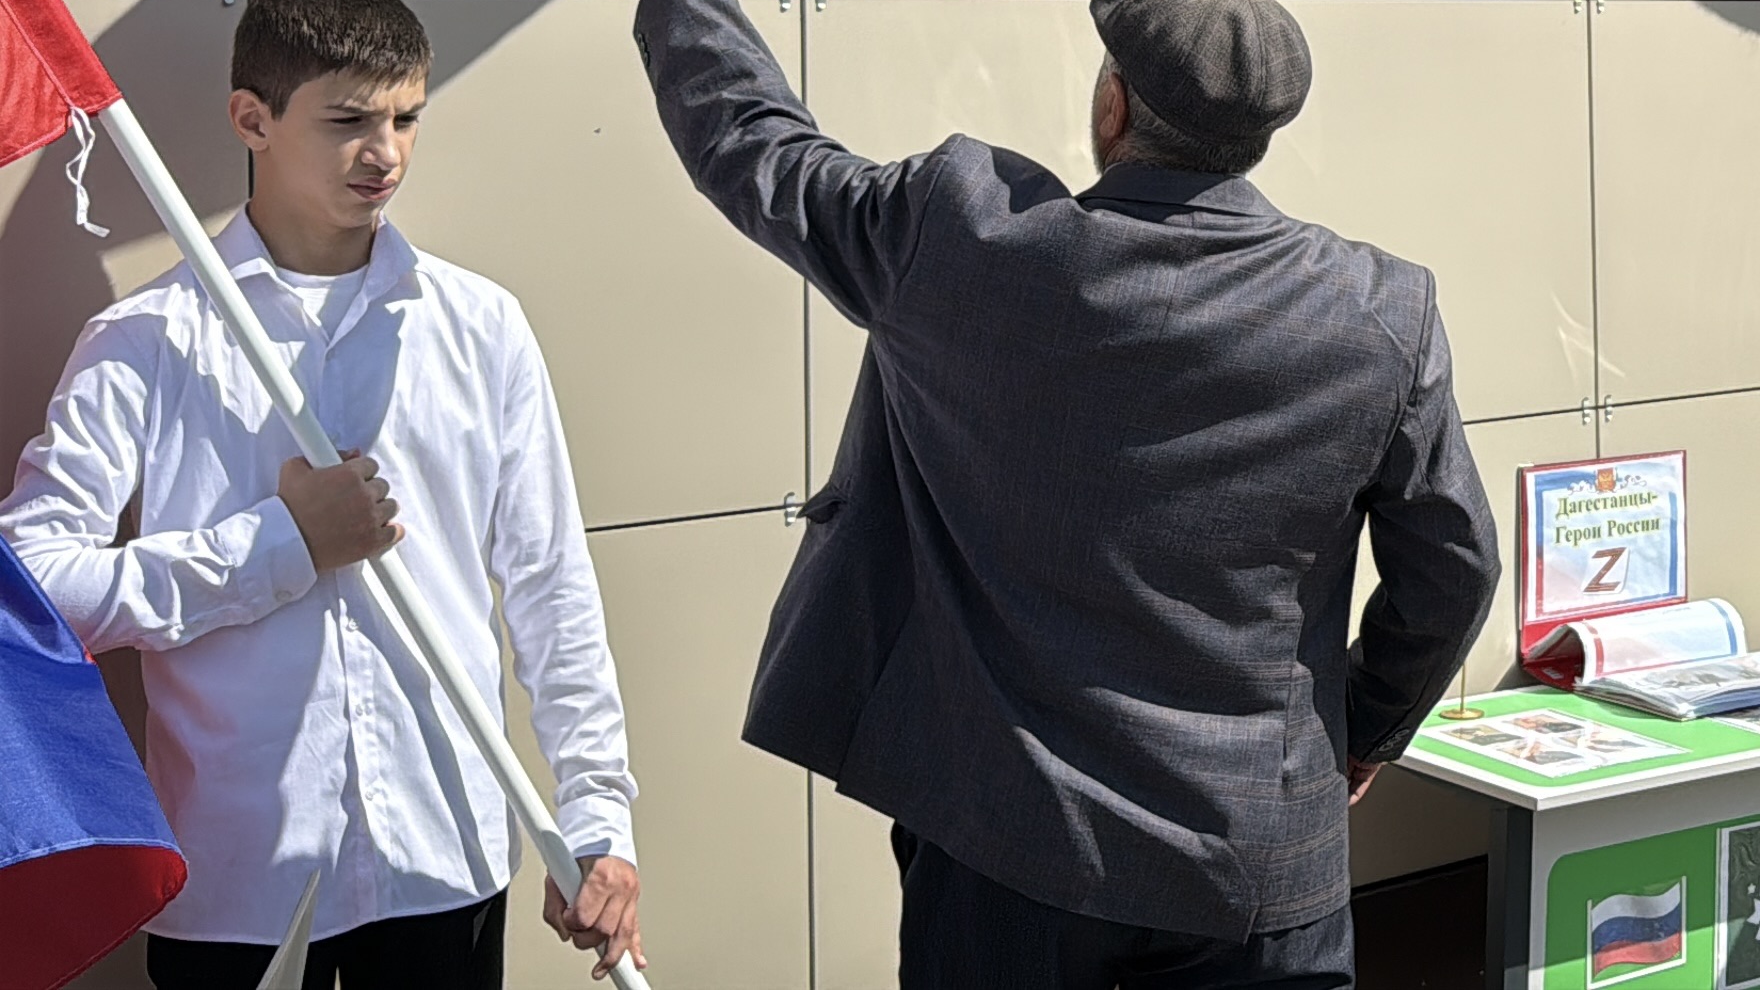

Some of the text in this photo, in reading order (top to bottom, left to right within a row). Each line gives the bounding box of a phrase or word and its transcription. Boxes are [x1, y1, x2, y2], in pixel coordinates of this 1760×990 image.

[1555, 491, 1658, 521] Дагестанцы-
[1555, 517, 1661, 547] Герои России
[1582, 546, 1628, 593] Z
